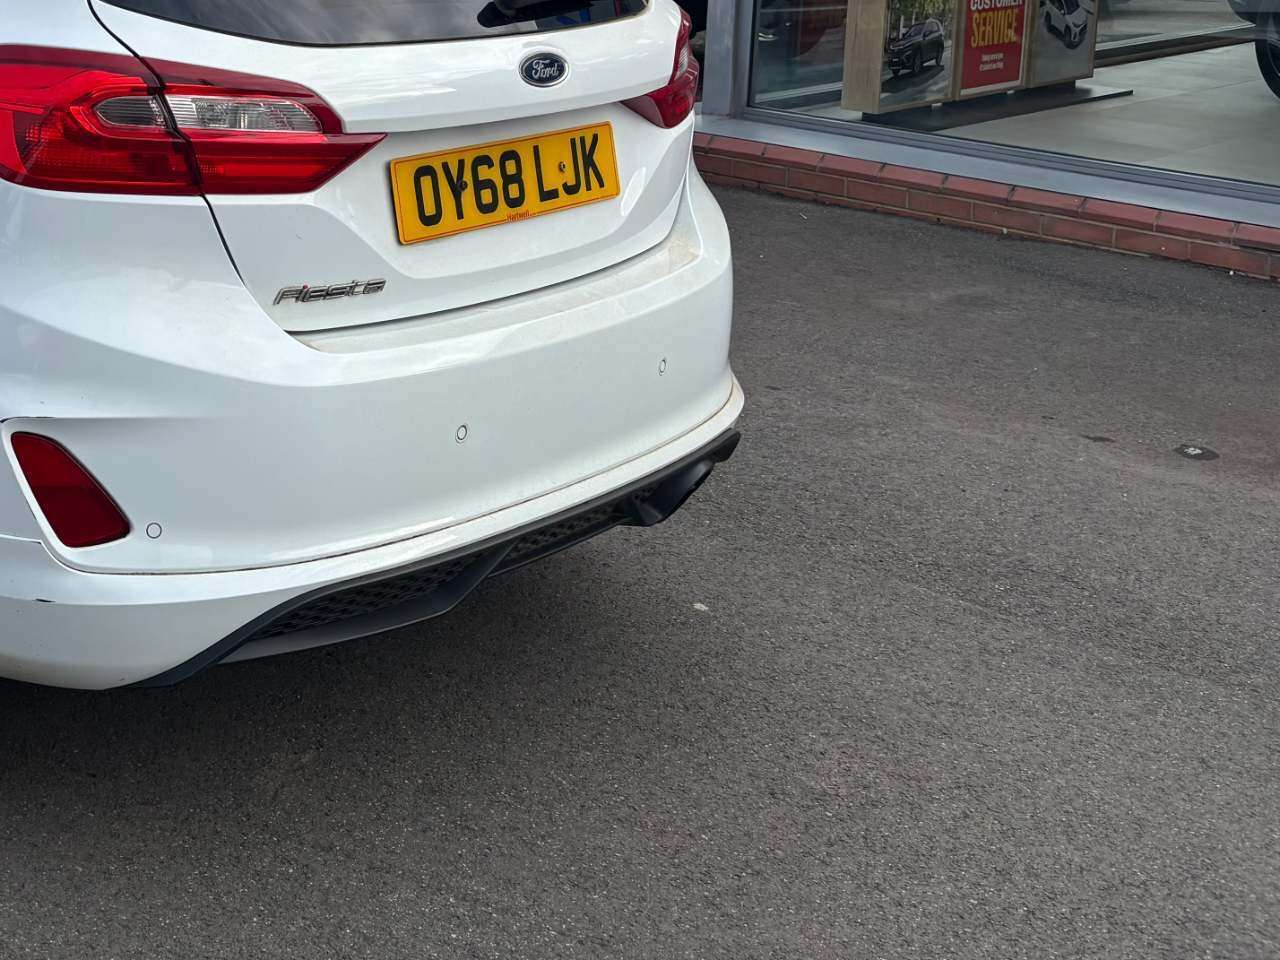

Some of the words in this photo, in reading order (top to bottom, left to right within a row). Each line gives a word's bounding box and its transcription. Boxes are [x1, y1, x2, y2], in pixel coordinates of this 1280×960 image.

[971, 9, 1019, 48] SERVICE
[532, 60, 559, 79] Ford
[413, 149, 526, 227] OY68
[533, 133, 605, 203] LJK
[273, 278, 387, 306] Fiesta
